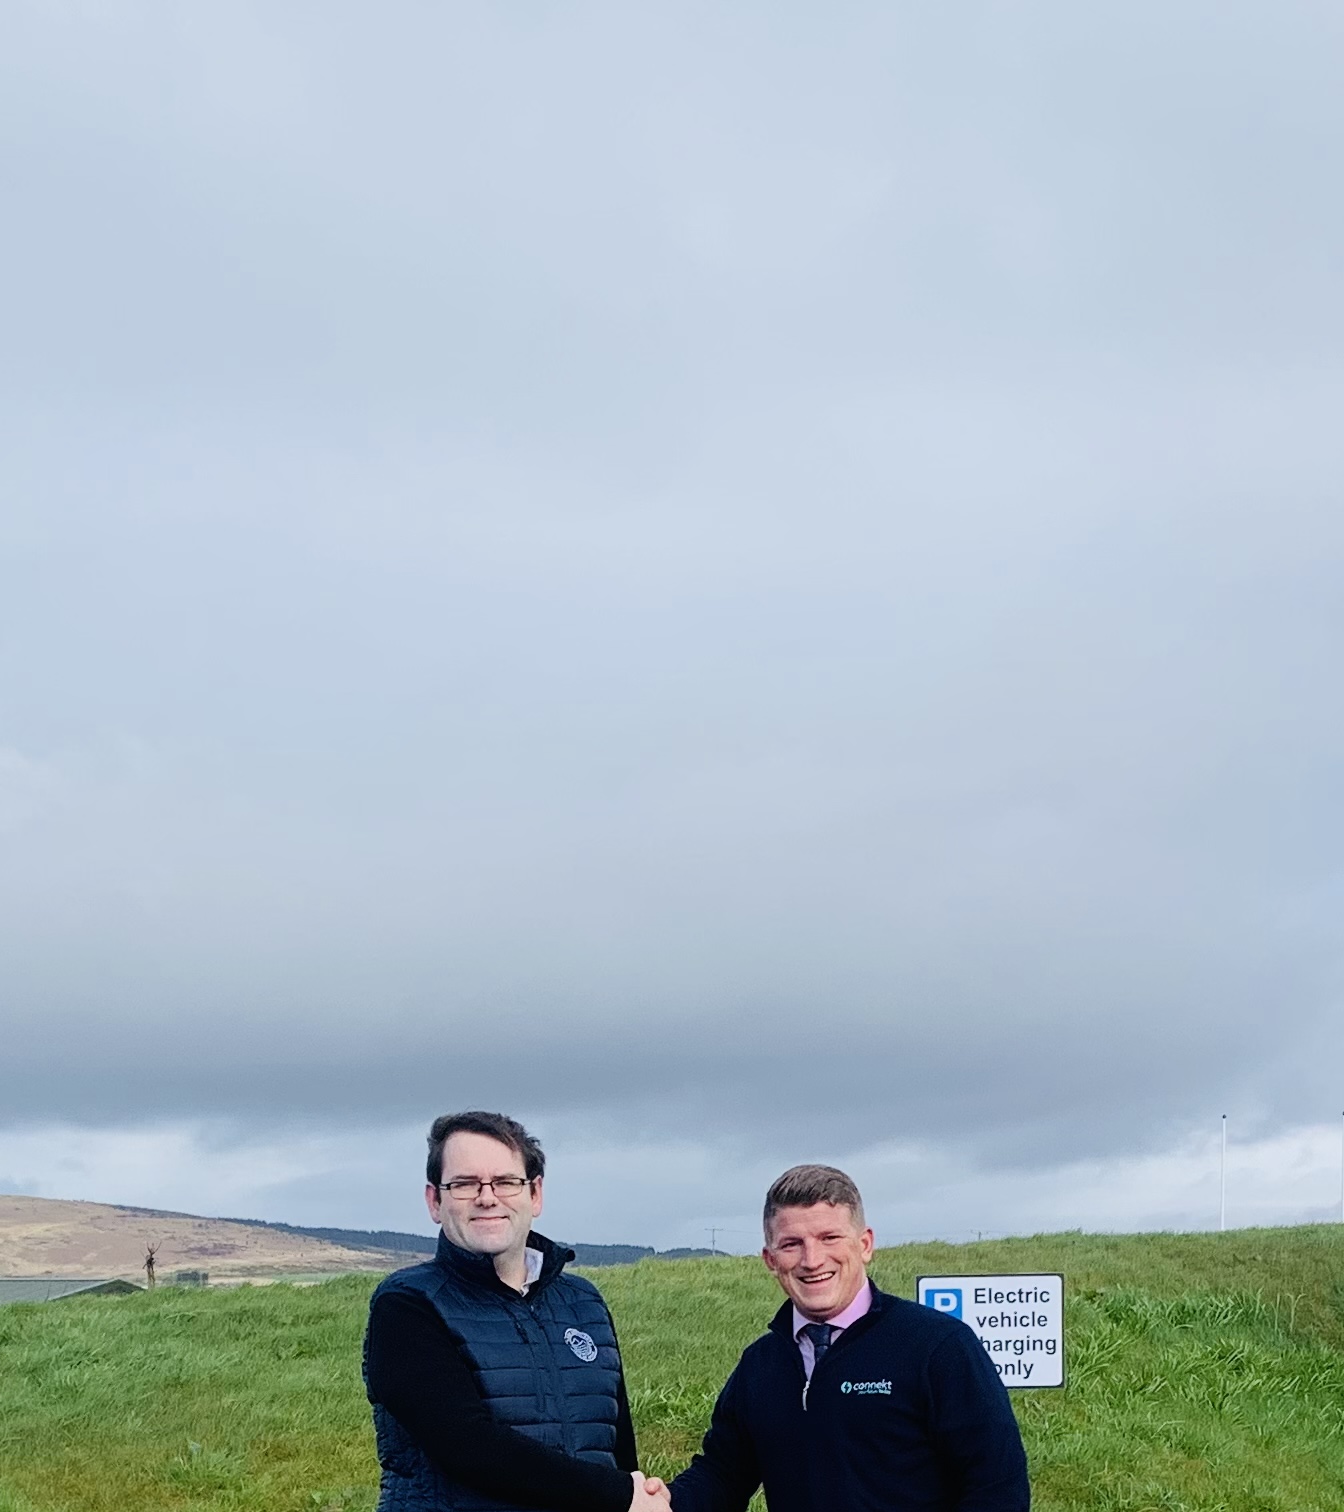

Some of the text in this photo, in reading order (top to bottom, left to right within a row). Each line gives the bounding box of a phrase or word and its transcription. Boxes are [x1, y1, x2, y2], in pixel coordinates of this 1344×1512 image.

[974, 1287, 1051, 1304] Electric
[976, 1311, 1048, 1328] vehicle
[979, 1335, 1057, 1355] harging
[852, 1378, 893, 1391] connekt
